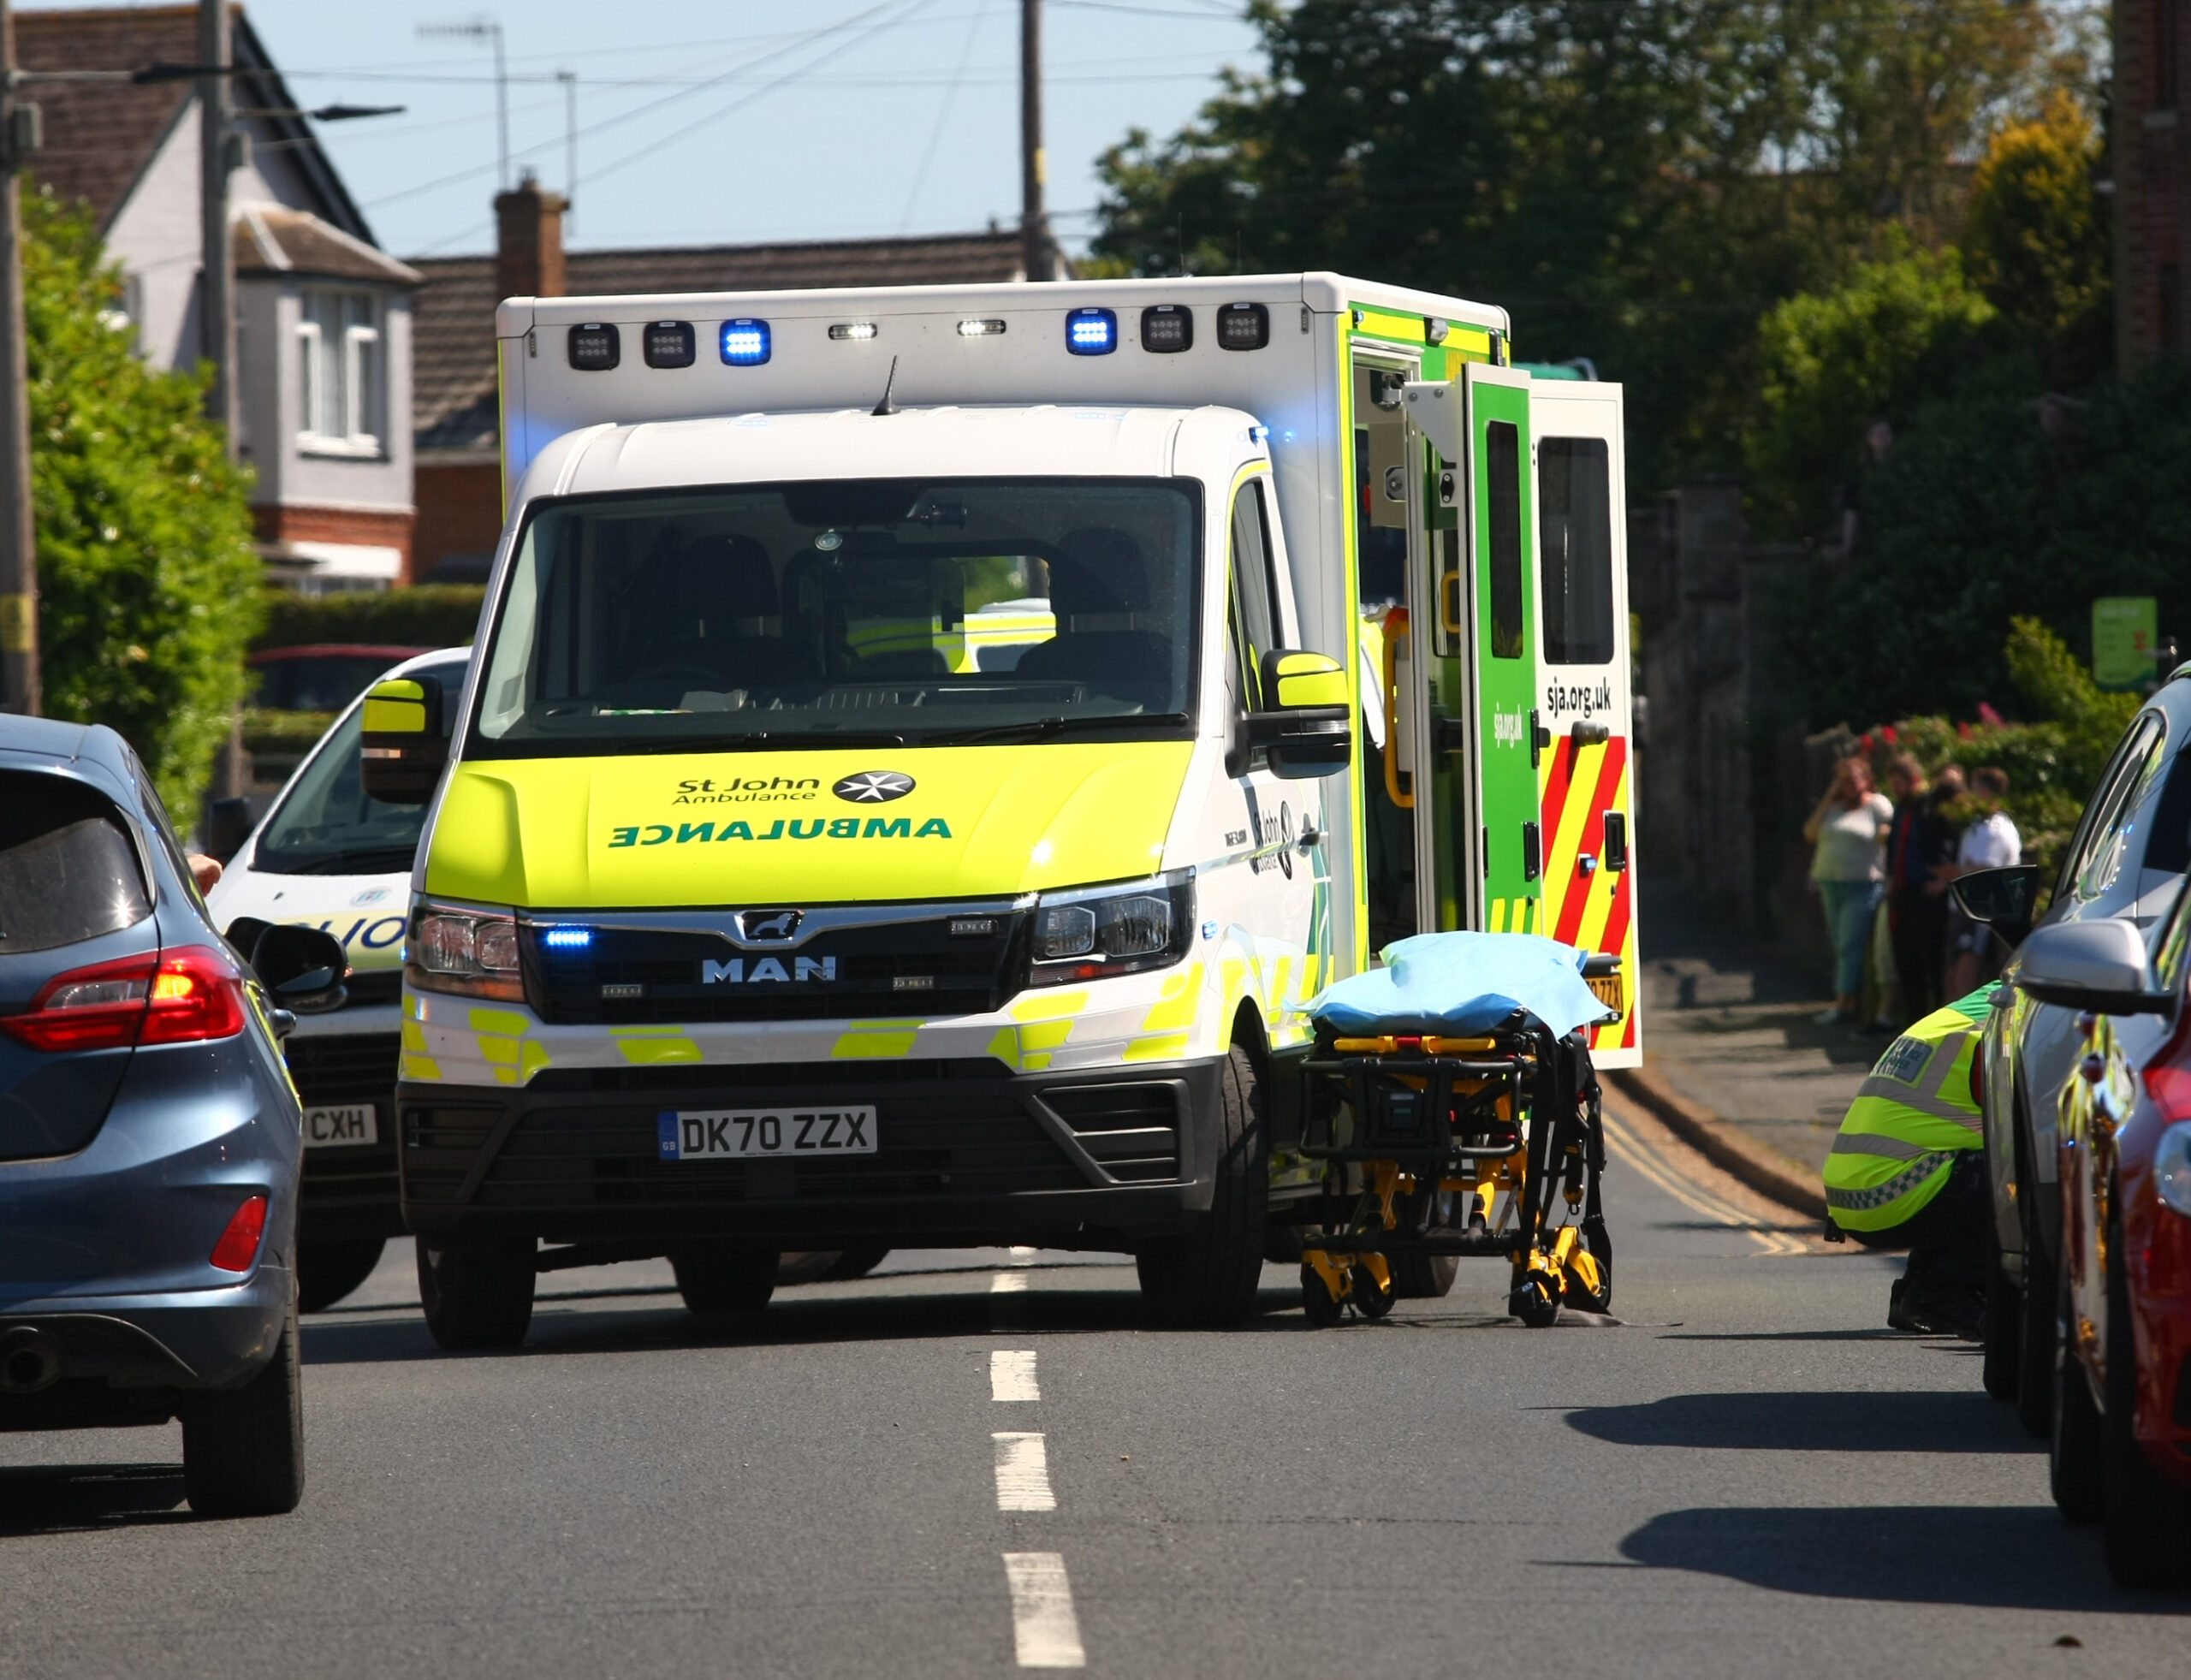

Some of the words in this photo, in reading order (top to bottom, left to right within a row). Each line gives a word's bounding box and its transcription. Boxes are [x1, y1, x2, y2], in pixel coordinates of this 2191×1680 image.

[1547, 675, 1612, 719] sja.org.uk
[672, 792, 816, 805] Ambulance
[676, 780, 715, 794] St
[724, 777, 820, 792] John
[702, 955, 836, 984] MAN
[311, 1110, 365, 1141] CXH
[682, 1115, 781, 1154] DK70
[793, 1112, 868, 1149] ZZX
[662, 1141, 676, 1151] GB
